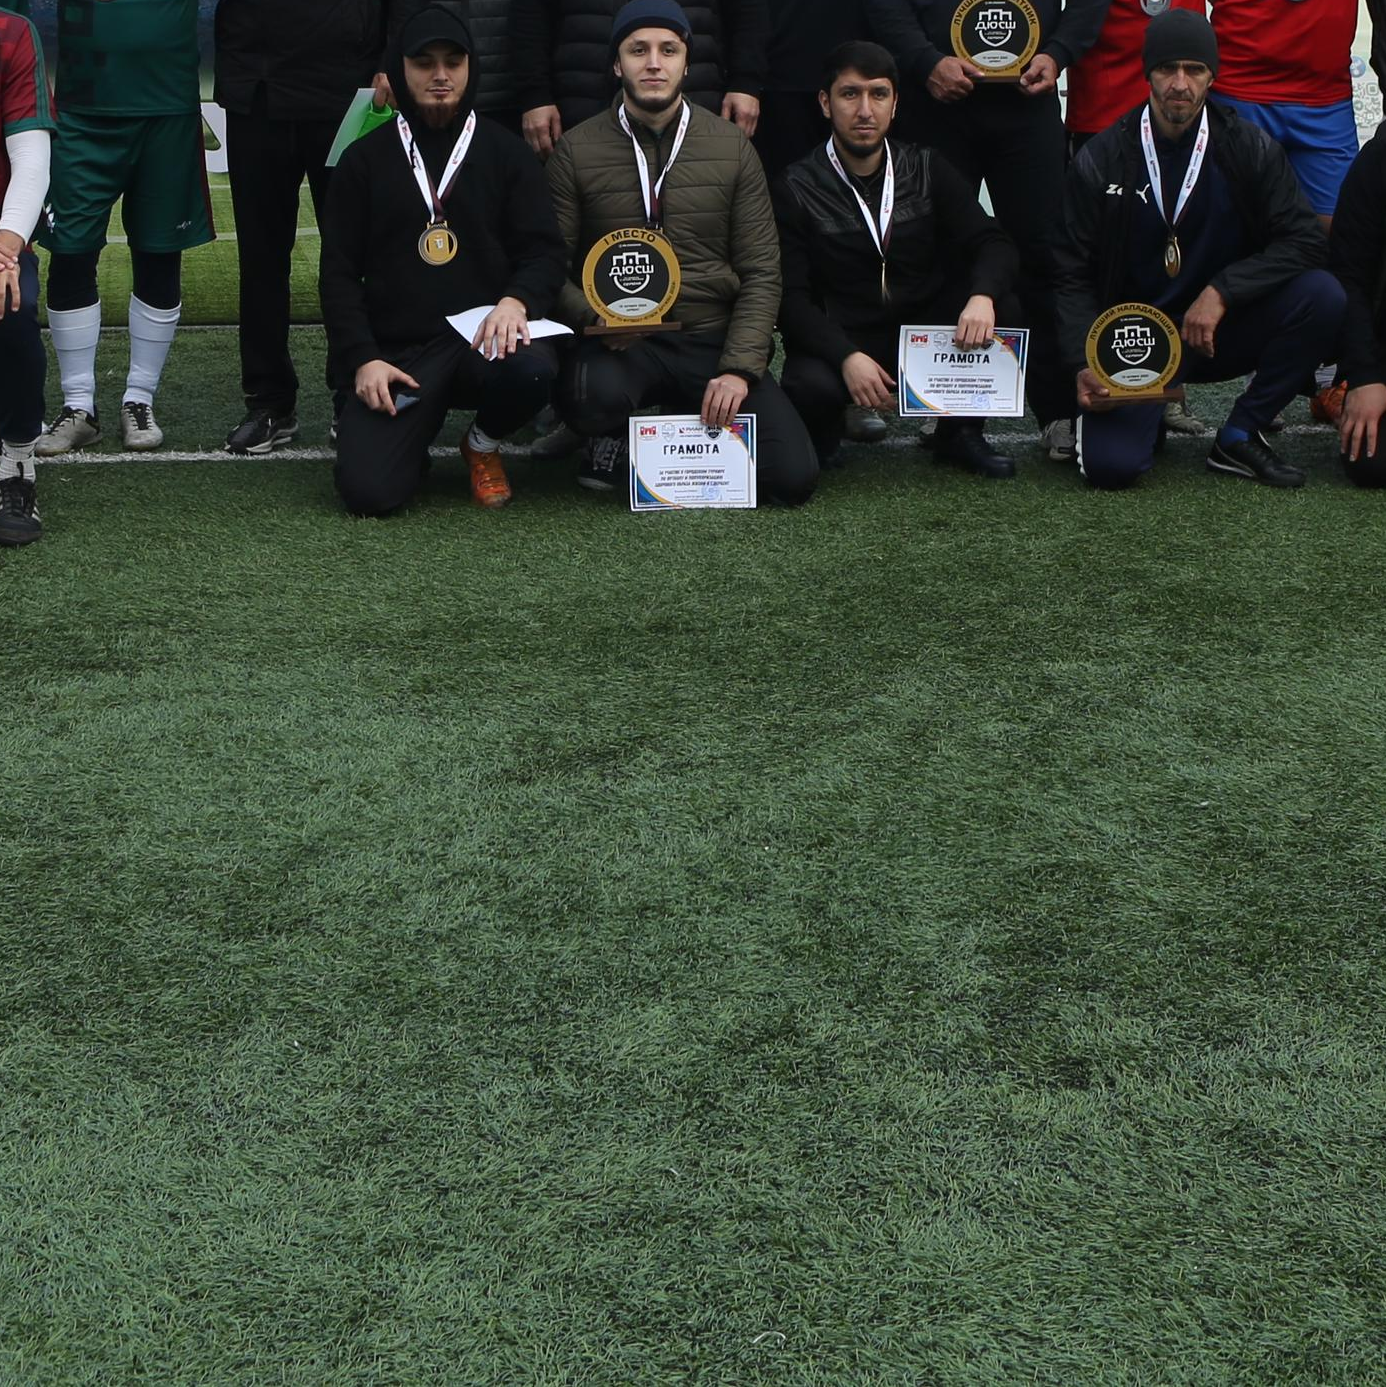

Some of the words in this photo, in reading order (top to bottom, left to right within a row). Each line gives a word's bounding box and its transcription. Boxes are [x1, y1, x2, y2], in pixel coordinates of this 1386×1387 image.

[975, 20, 1016, 31] ДЮСШ
[611, 229, 656, 243] МЕСТО
[609, 264, 654, 277] ДЮСШ
[1089, 309, 1117, 341] ЛУЧШИЙ
[1111, 337, 1155, 349] ДЮСШ
[933, 353, 991, 364] ГРАМОТА
[663, 444, 720, 455] ГРАМОТА
